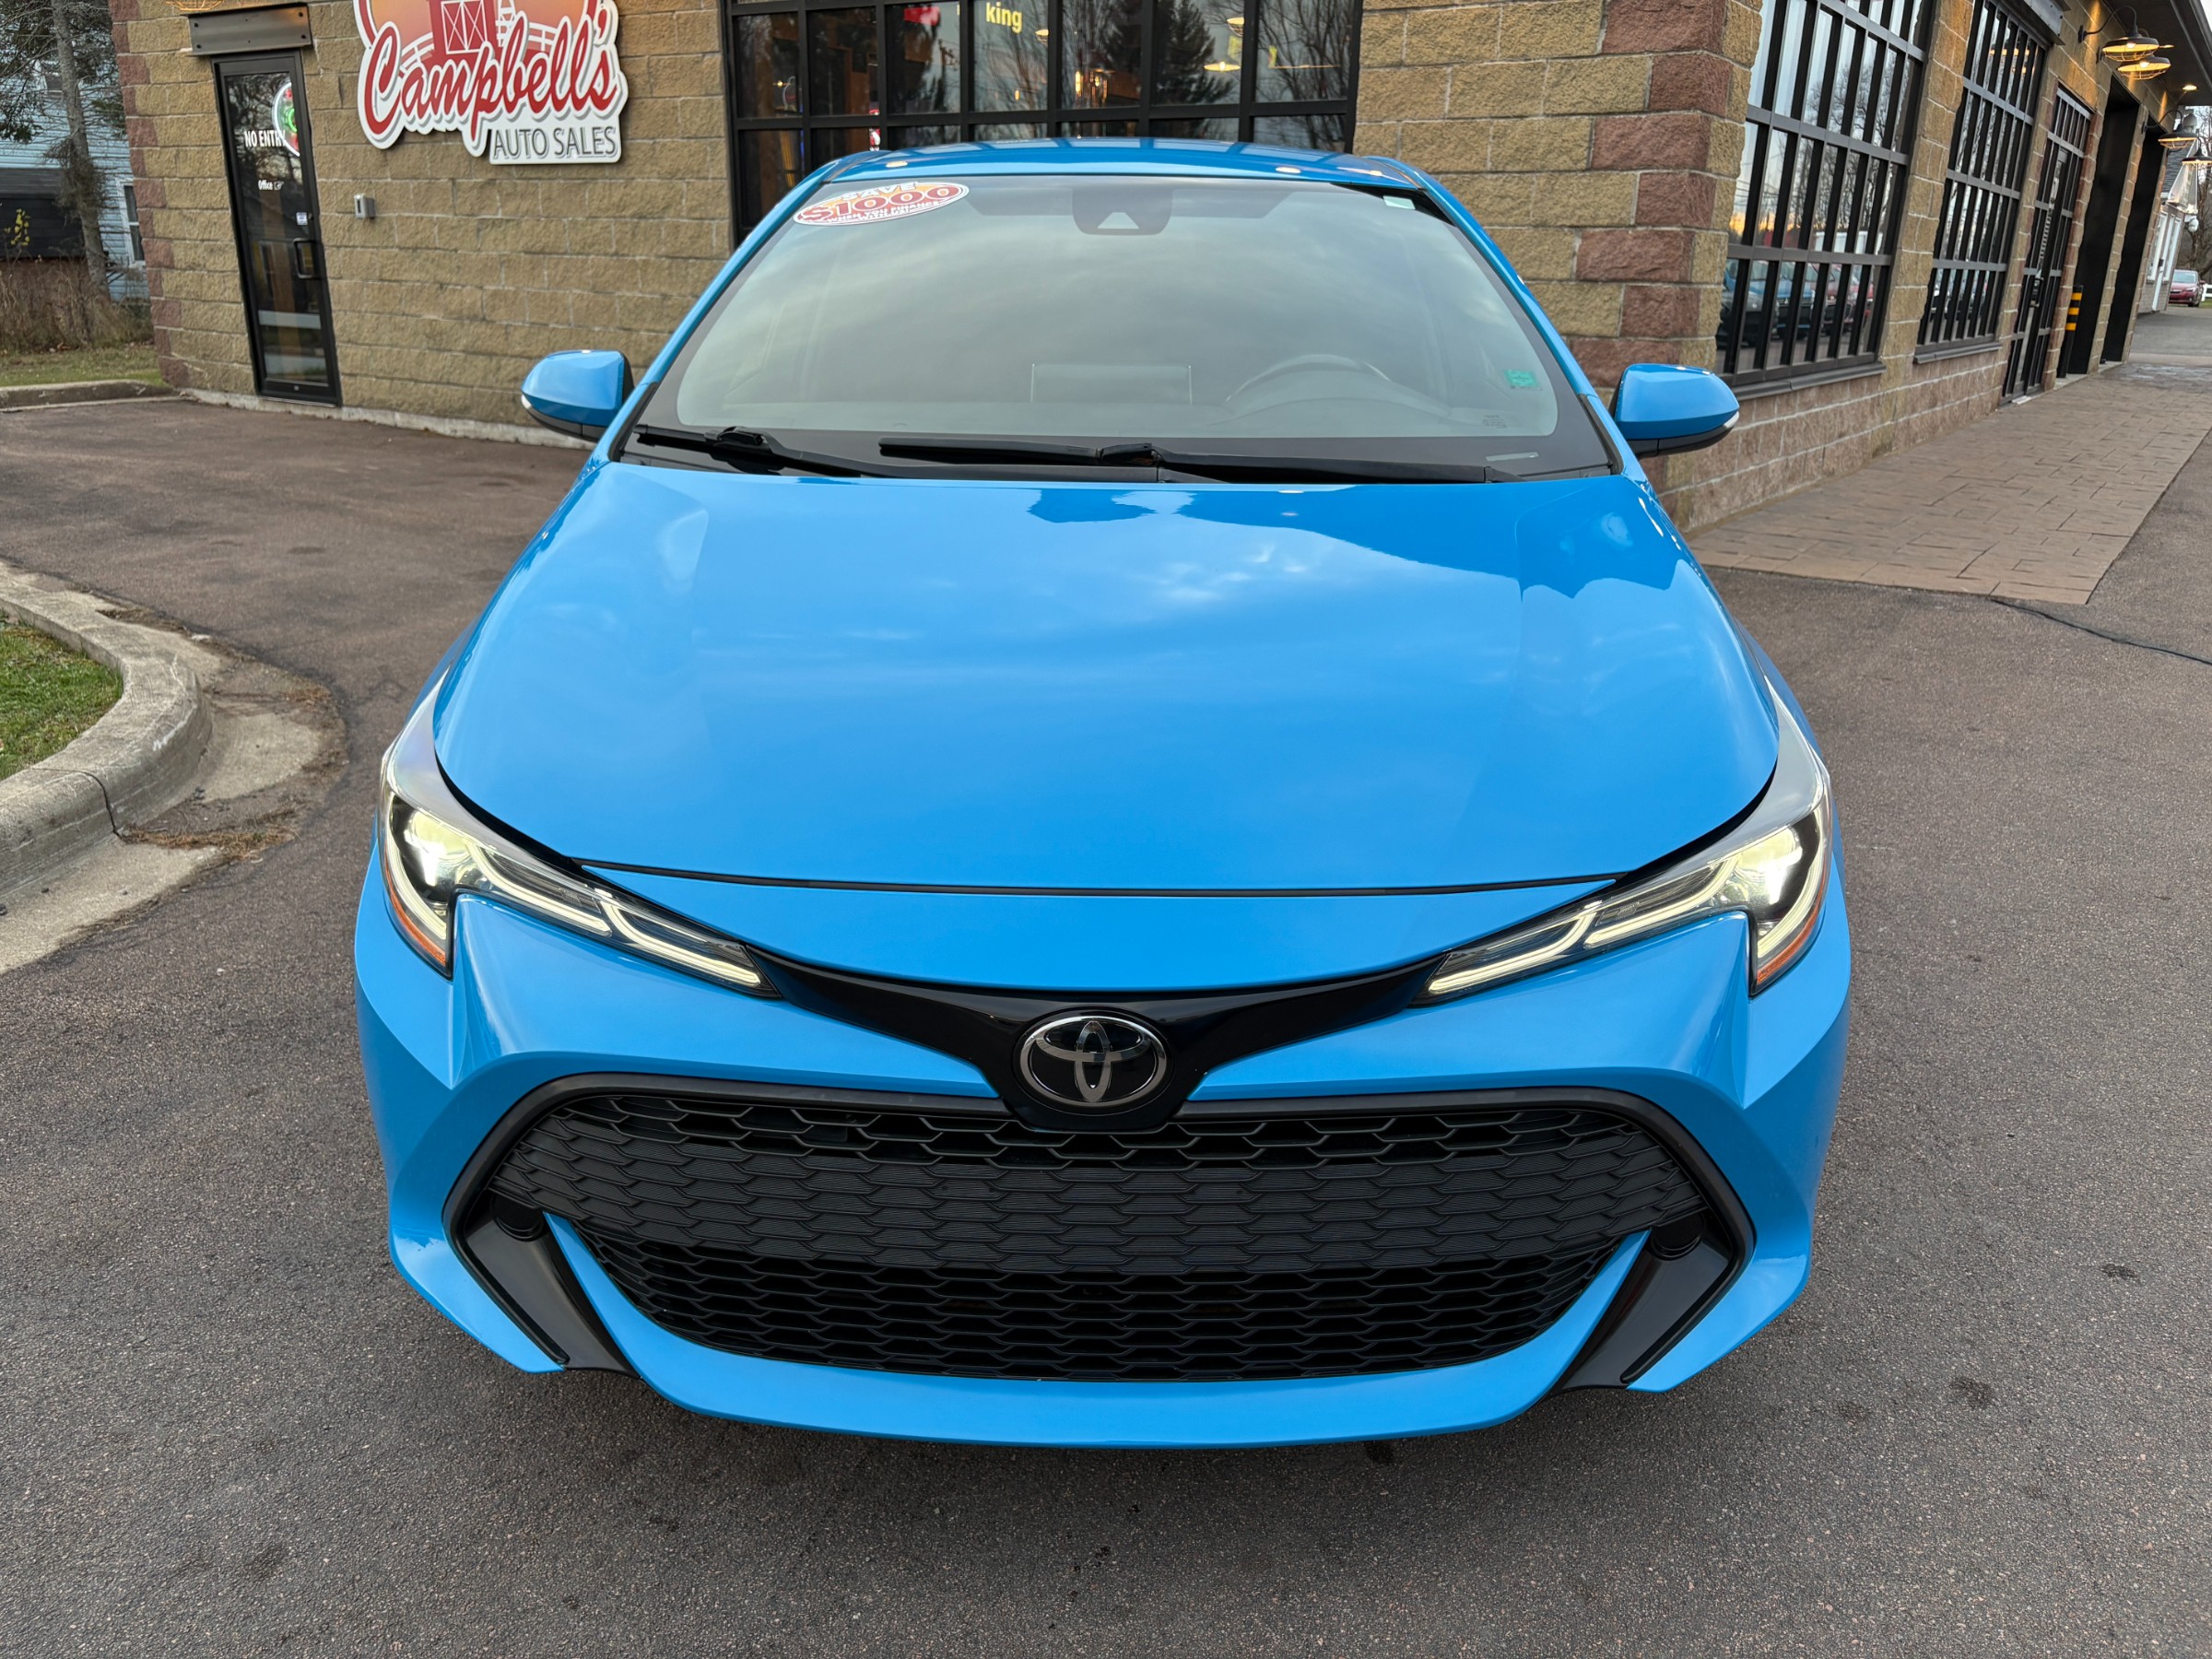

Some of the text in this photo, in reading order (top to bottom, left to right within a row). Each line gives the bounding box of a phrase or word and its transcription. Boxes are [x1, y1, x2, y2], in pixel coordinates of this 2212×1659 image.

[365, 8, 618, 142] Campbell's
[244, 130, 257, 147] NO
[493, 126, 618, 158] AUTO SALES
[257, 179, 274, 191] Office
[840, 182, 918, 201] SAVE
[801, 185, 961, 221] $1000
[827, 200, 941, 222] WHEN YOU FINANCE
